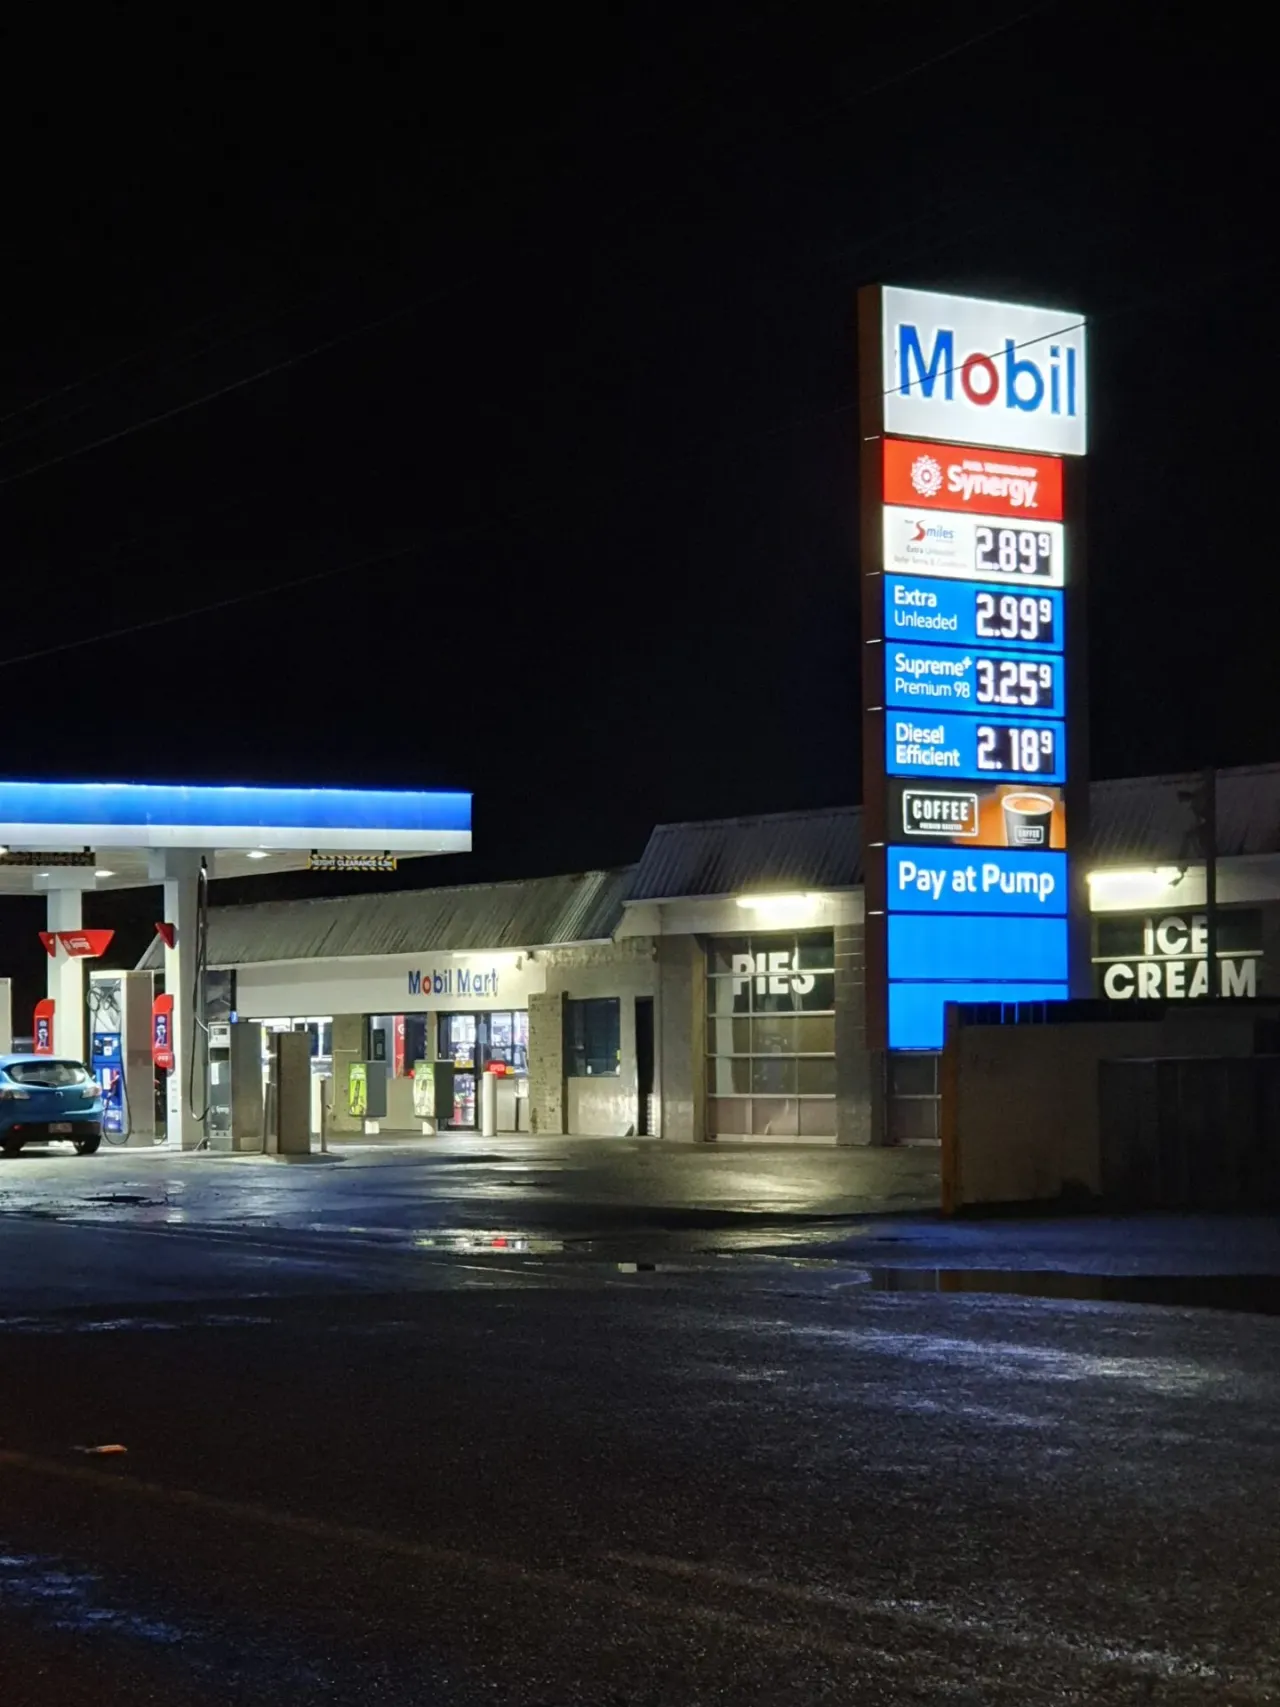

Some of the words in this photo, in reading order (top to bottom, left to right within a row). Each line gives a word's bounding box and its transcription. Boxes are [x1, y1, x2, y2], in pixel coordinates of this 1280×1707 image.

[898, 324, 1077, 416] Mobil
[947, 464, 1038, 508] Synergy
[910, 519, 955, 542] Smiles
[894, 585, 937, 608] Extra
[894, 610, 958, 631] Unleaded
[895, 678, 952, 697] Premium
[954, 681, 970, 698] 98
[895, 722, 945, 744] Diesel
[896, 744, 960, 767] Efficient
[912, 799, 969, 821] COFFEE
[337, 859, 376, 867] CLEARANCE
[899, 861, 946, 899] Pay
[952, 865, 976, 892] at
[982, 864, 1054, 902] Pump
[1144, 915, 1208, 955] ICE
[408, 969, 452, 995] Mobil
[457, 968, 498, 994] Mart
[732, 951, 815, 995] PIES
[1104, 959, 1256, 999] CREAM
